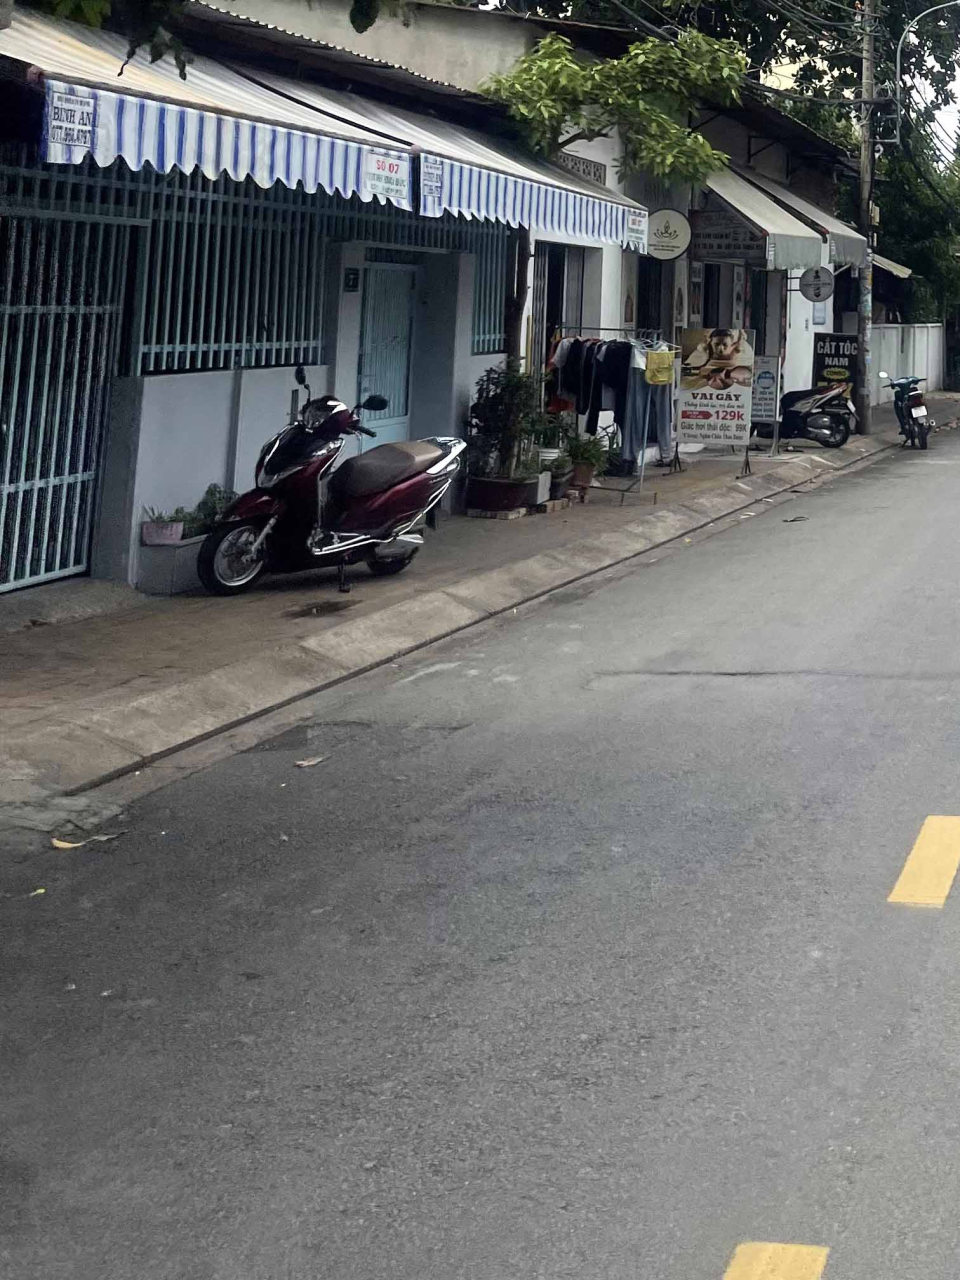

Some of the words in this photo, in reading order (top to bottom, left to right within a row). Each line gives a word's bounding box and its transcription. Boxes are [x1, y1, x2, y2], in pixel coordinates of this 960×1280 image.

[388, 163, 400, 174] 07
[838, 340, 858, 355] TÓC
[824, 356, 849, 366] NAM
[691, 392, 713, 400] VAI
[714, 410, 745, 421] 129k
